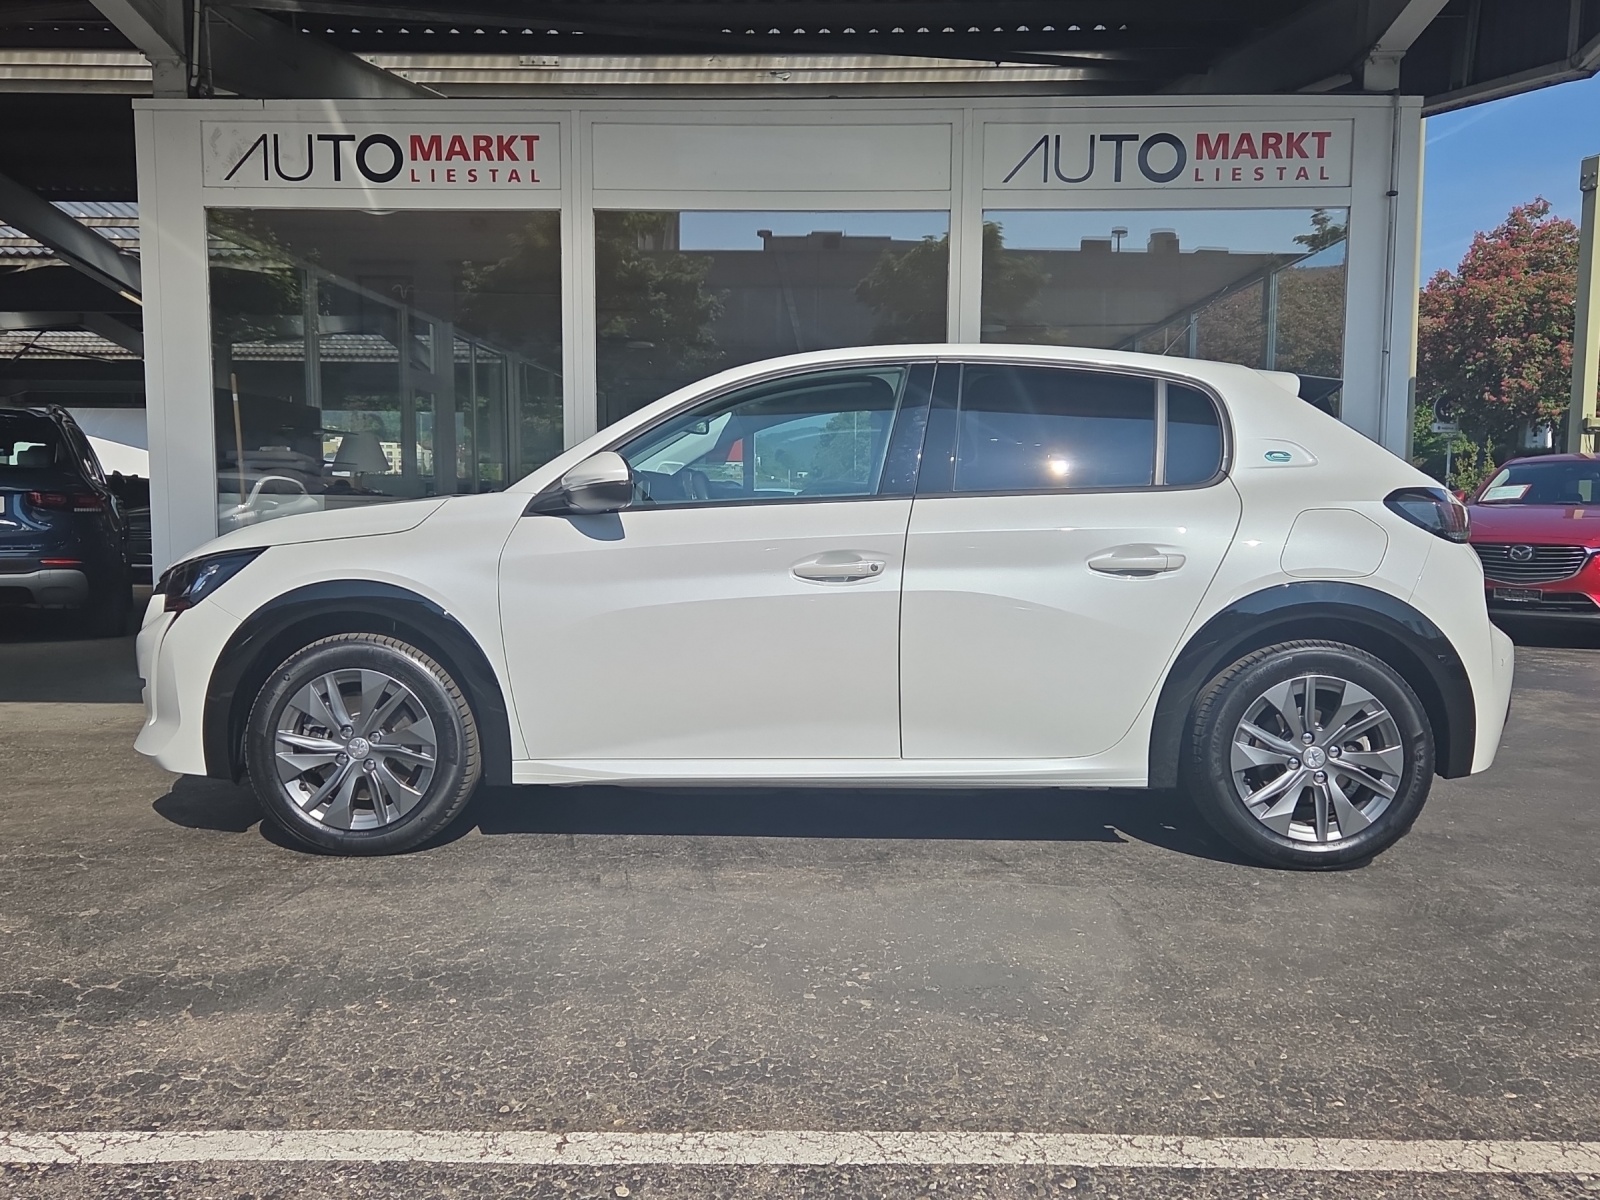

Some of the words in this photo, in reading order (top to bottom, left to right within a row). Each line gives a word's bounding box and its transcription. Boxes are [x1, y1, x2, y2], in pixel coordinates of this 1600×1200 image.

[224, 133, 404, 183] AUTO
[410, 134, 540, 162] MARKT
[1002, 132, 1187, 183] AUTO
[1195, 131, 1332, 160] MARKT
[410, 169, 541, 183] LIESTAL
[1194, 166, 1330, 182] LIESTAL
